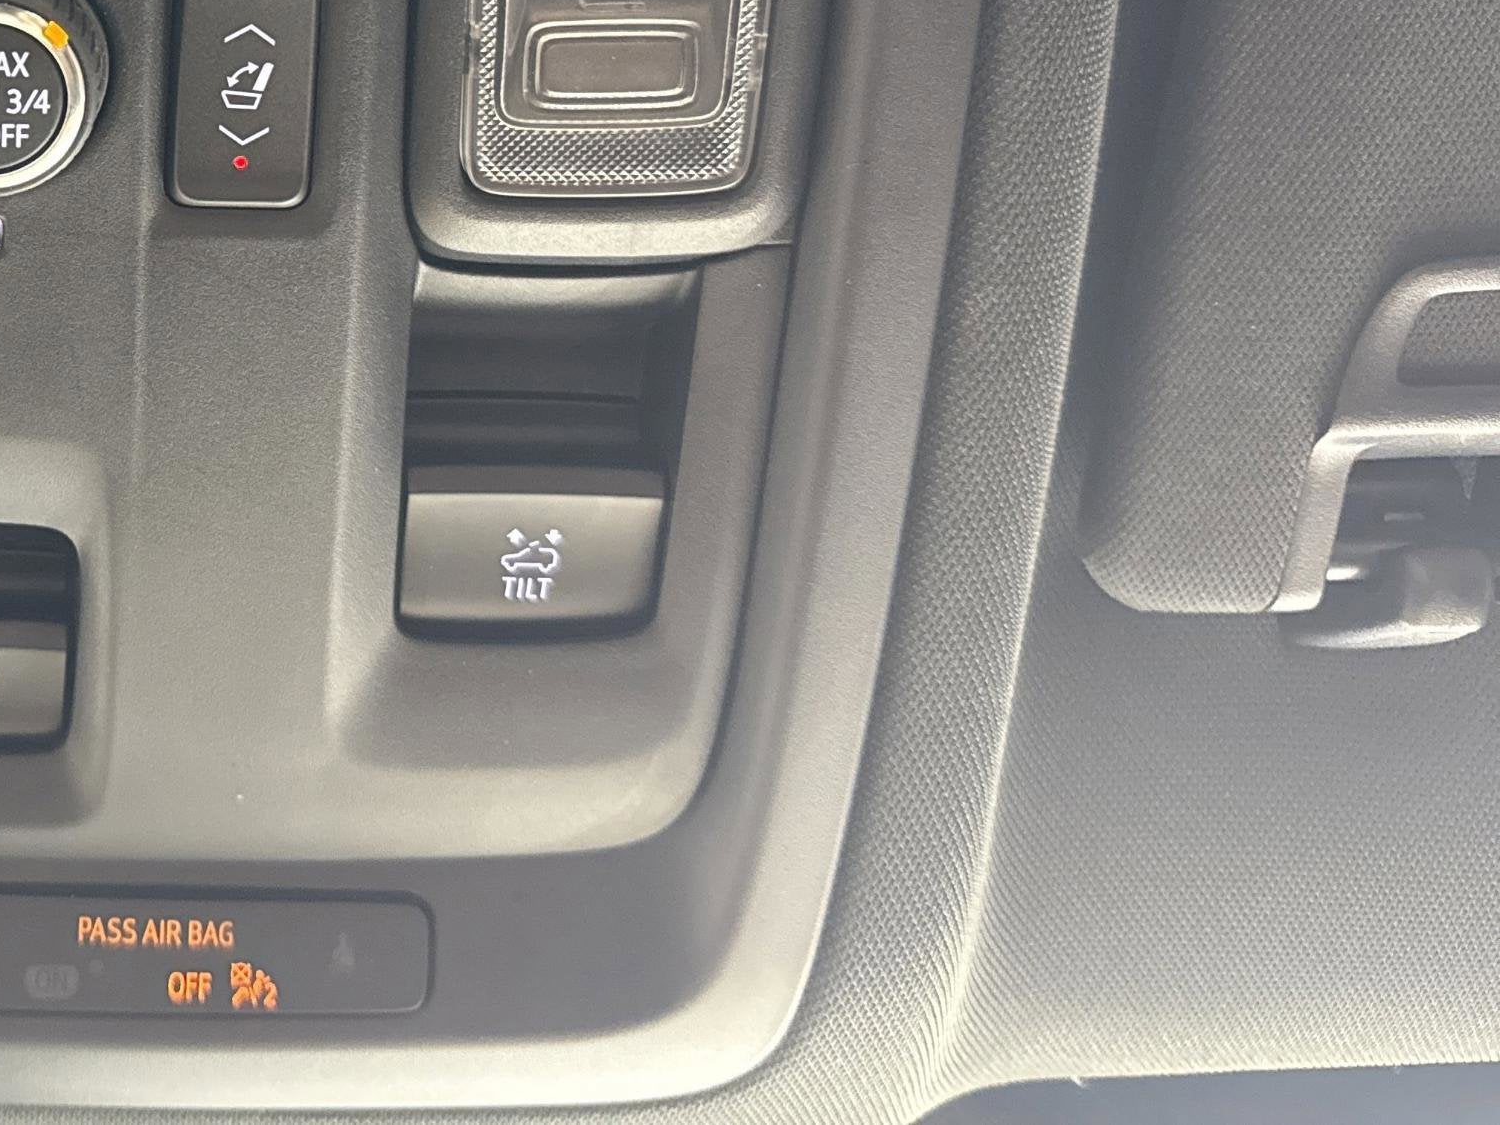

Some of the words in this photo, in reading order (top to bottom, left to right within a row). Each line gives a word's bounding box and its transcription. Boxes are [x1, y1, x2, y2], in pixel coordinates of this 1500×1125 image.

[5, 89, 51, 116] 3/4
[501, 575, 553, 602] TILT
[77, 915, 137, 946] PASS
[141, 919, 182, 947] AIR
[187, 921, 235, 948] BAG
[167, 971, 212, 1003] OFF
